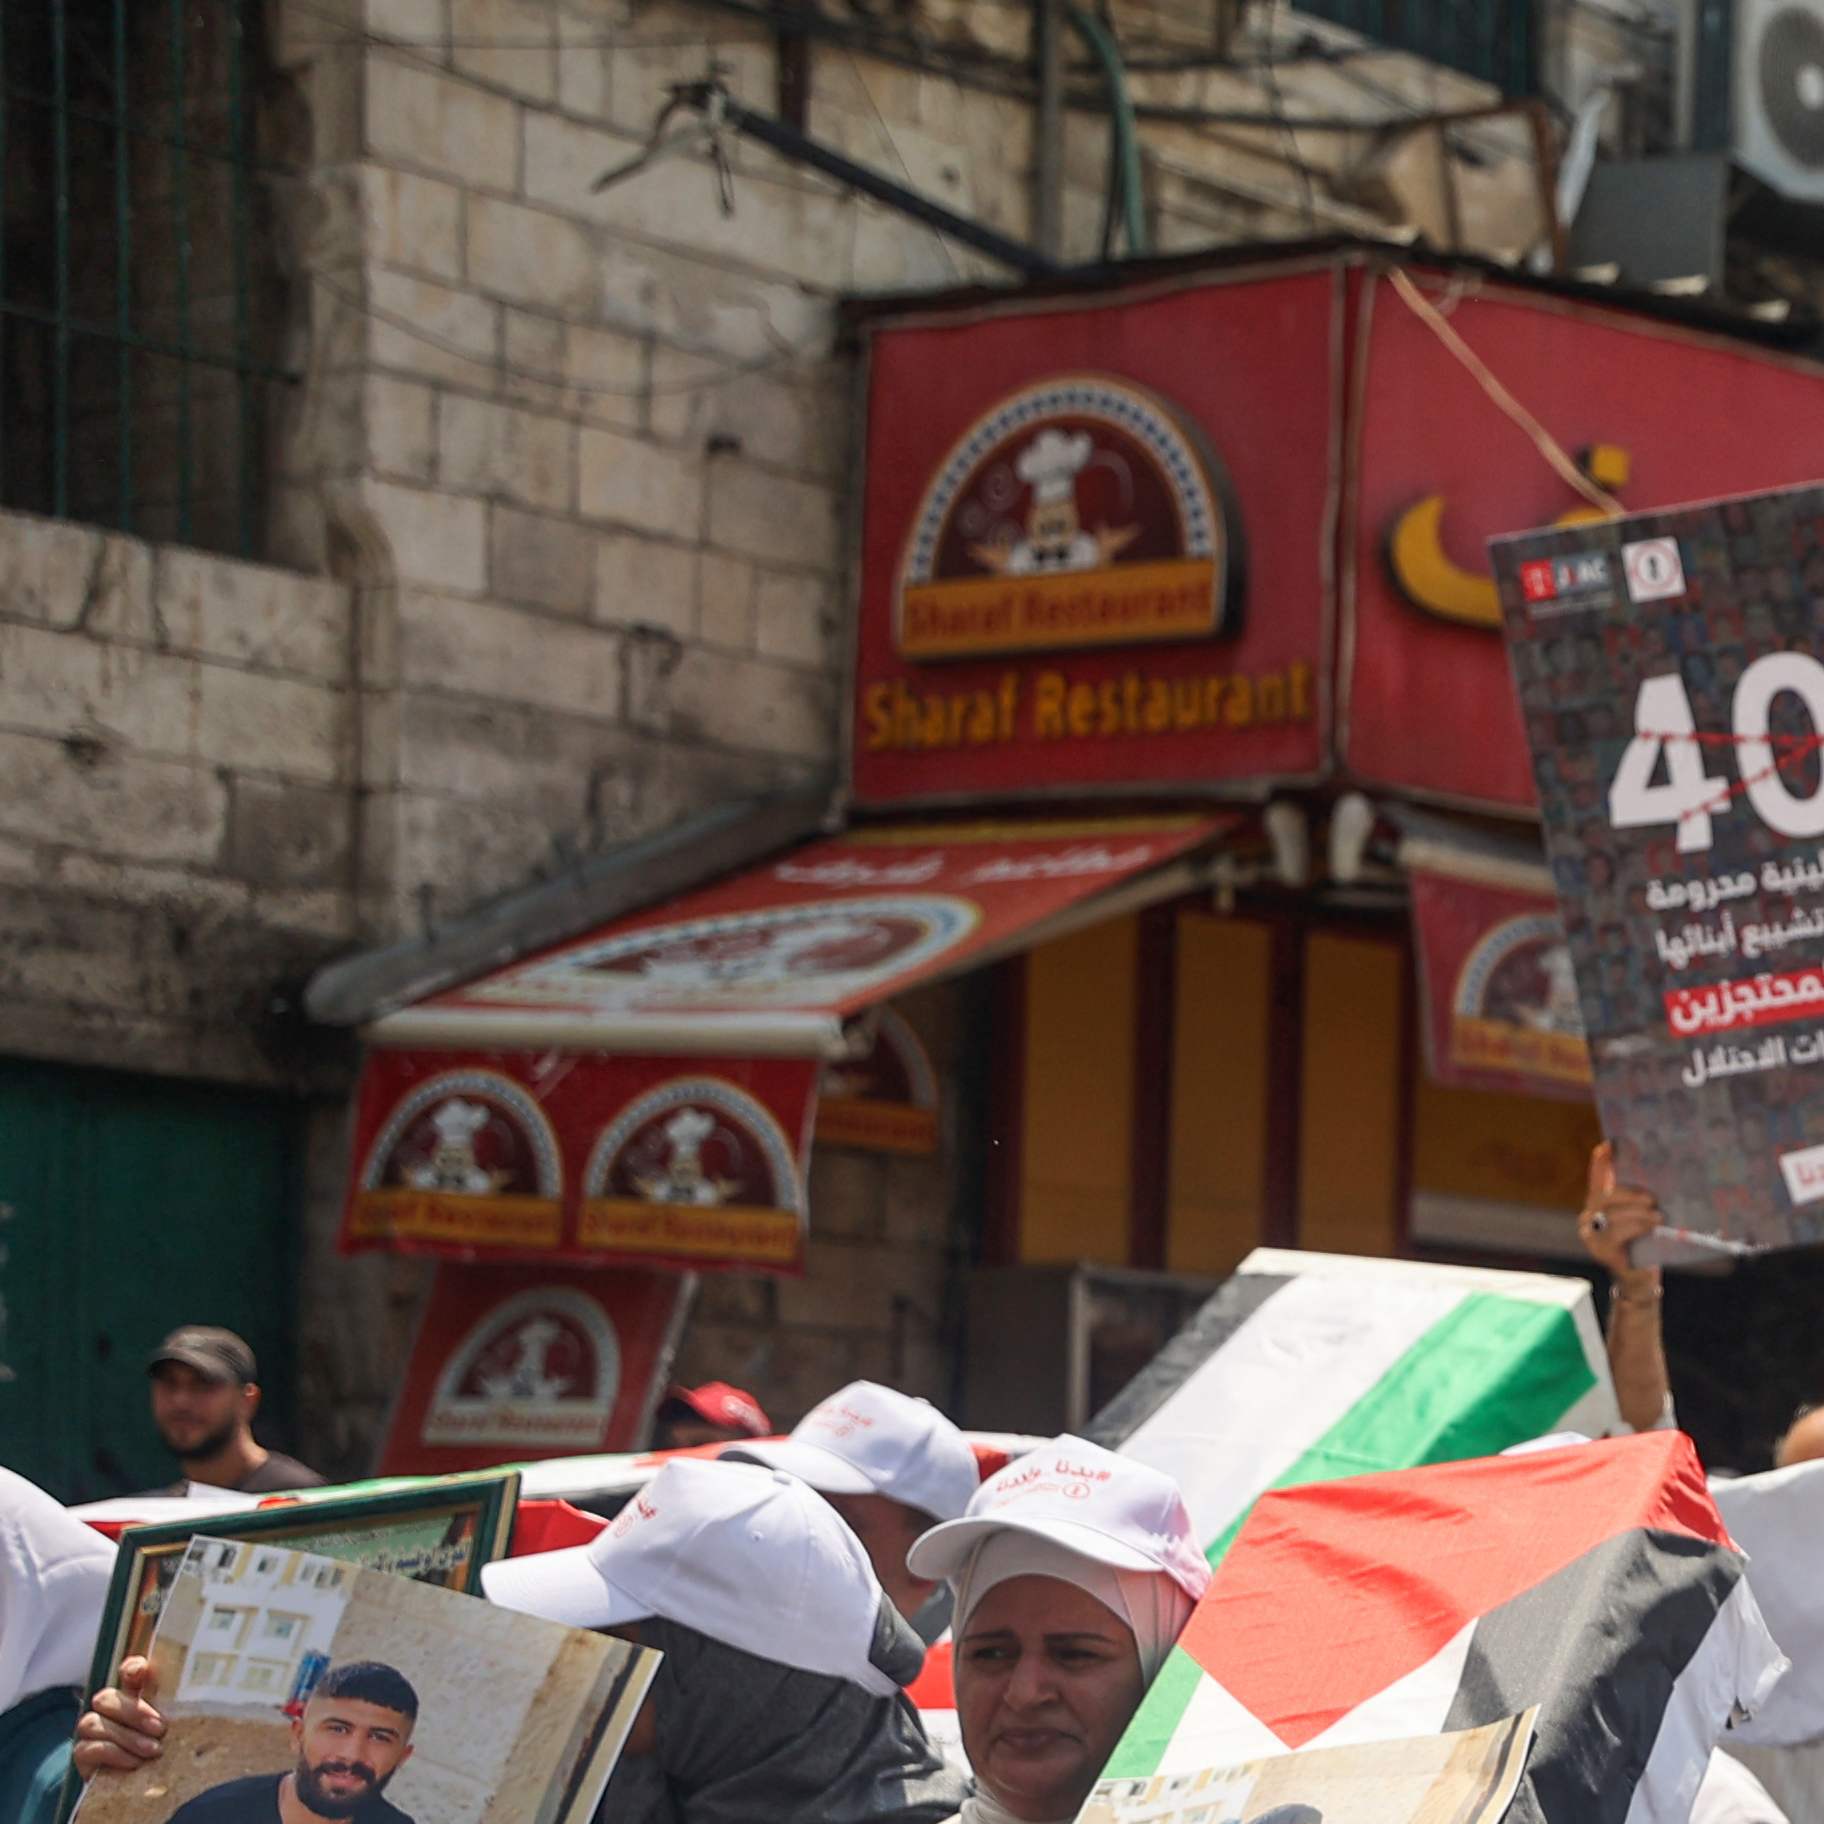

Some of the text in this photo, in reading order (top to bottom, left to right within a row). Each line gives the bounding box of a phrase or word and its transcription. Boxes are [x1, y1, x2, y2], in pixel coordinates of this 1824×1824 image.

[863, 661, 1313, 750] Sharaf Restaurant
[1646, 868, 1757, 910] محرومة
[1654, 910, 1738, 970] أبنائها
[1682, 1038, 1786, 1088] الاحتلال
